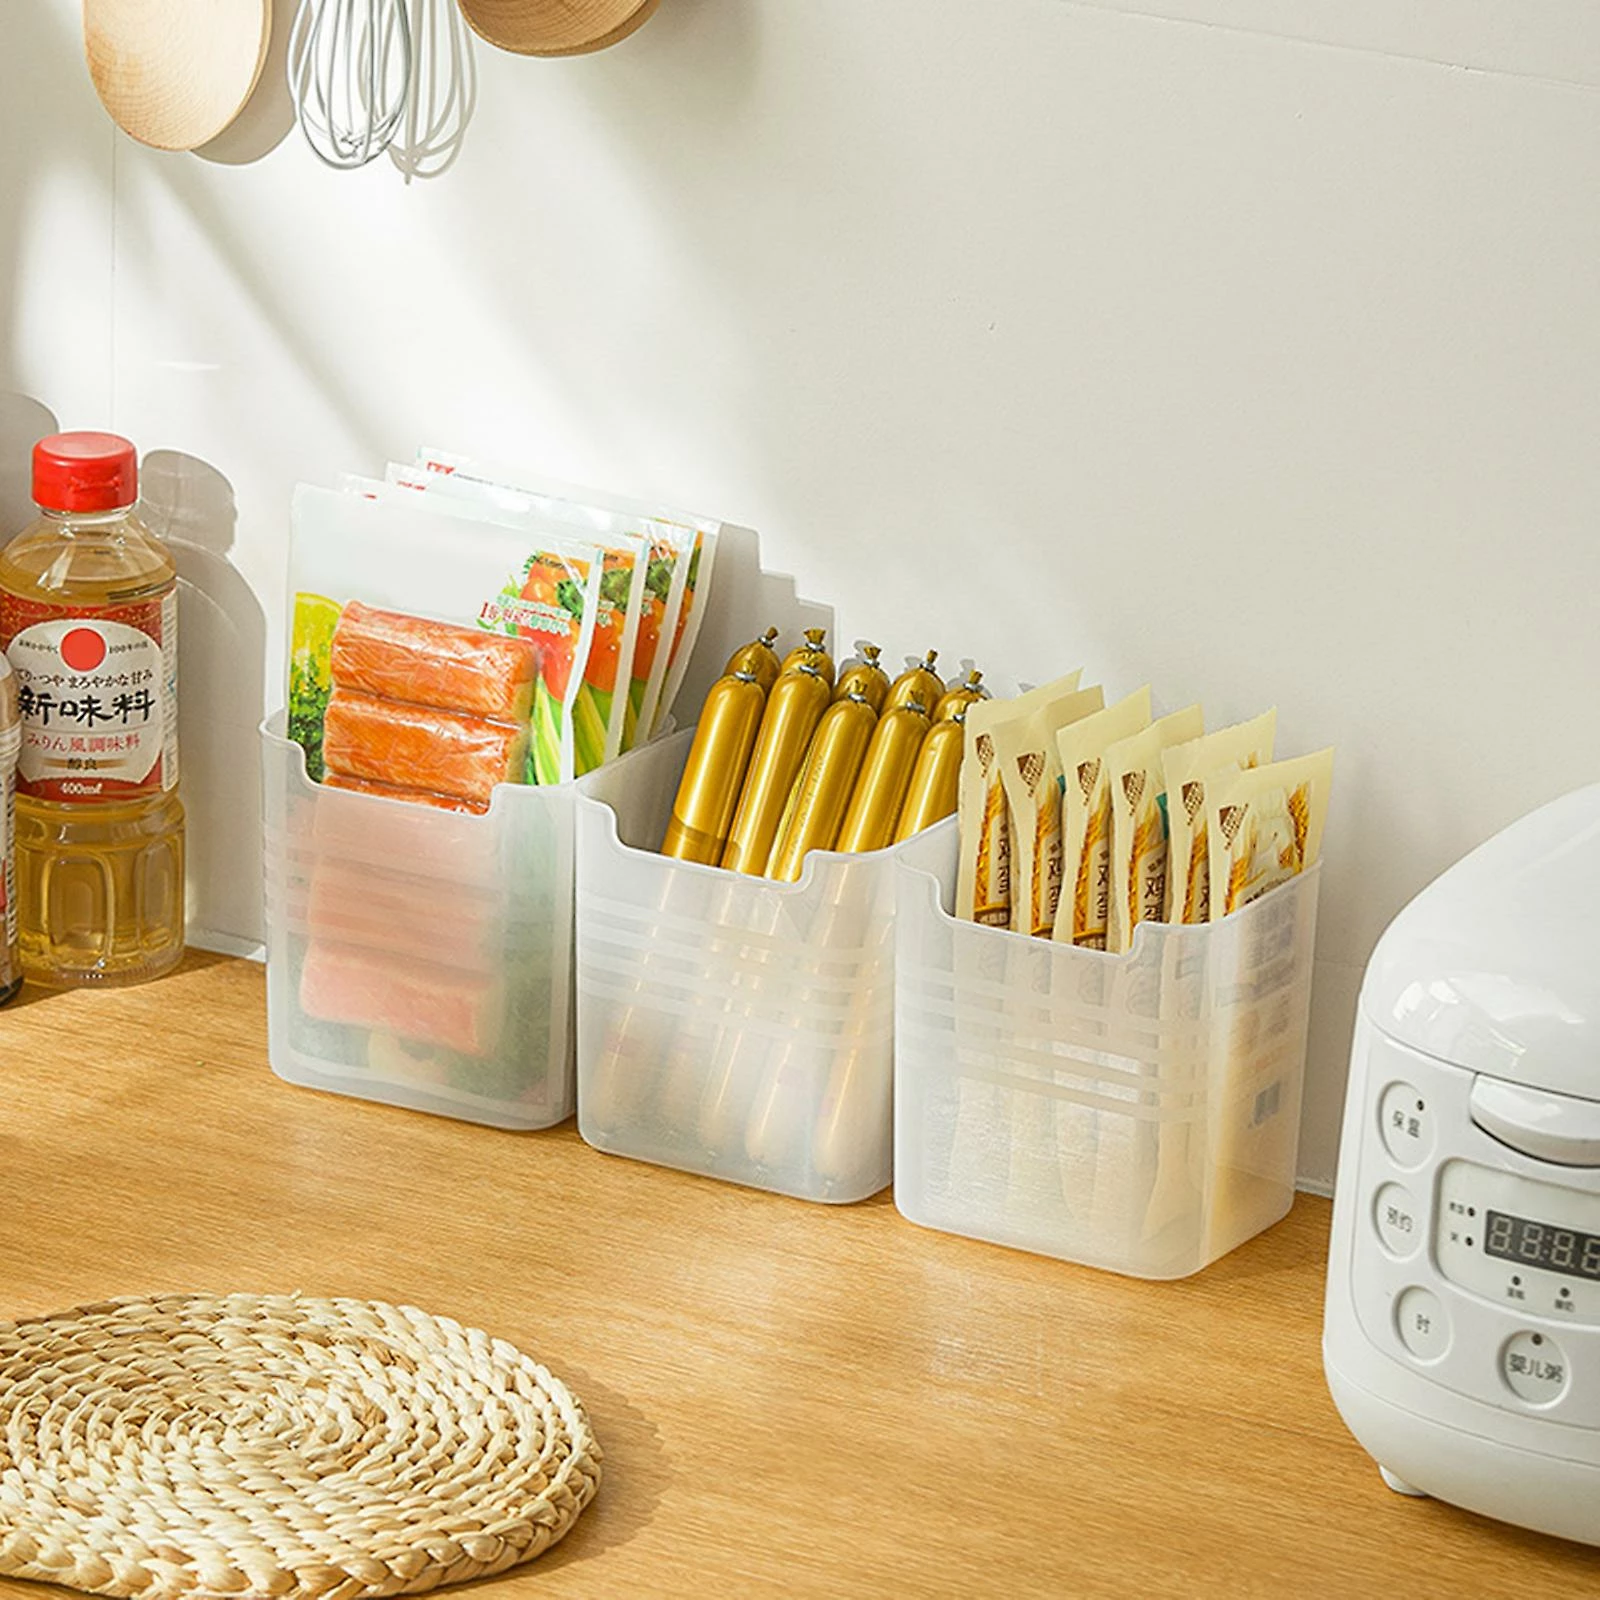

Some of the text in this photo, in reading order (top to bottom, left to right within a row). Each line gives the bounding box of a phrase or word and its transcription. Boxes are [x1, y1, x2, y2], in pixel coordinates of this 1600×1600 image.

[17, 684, 156, 728] 新味料
[26, 733, 141, 752] みりん風調味料
[1508, 1352, 1564, 1384] 婴儿粥
